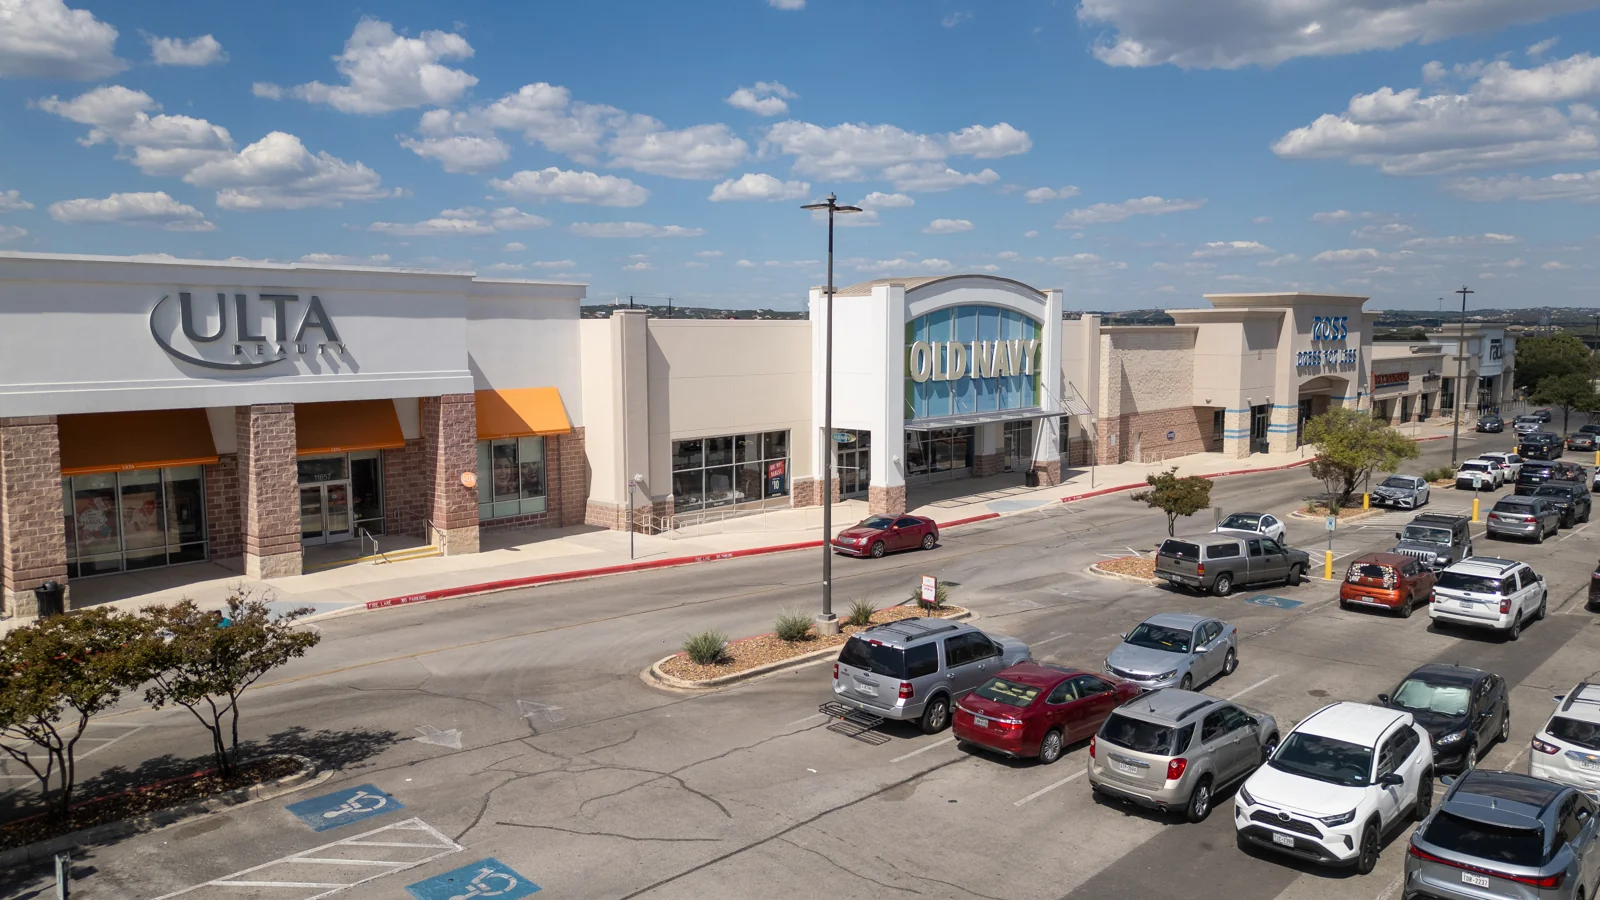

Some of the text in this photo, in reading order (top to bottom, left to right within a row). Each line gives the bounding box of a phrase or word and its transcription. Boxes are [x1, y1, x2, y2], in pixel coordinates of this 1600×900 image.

[179, 292, 339, 342] ULTA
[1312, 316, 1348, 341] ROSS
[232, 343, 346, 356] BEAUTY
[910, 338, 1040, 383] OLD NAVY
[1297, 348, 1357, 367] DRESS FOR LESS
[380, 599, 392, 607] LANE
[408, 594, 427, 603] PARKING
